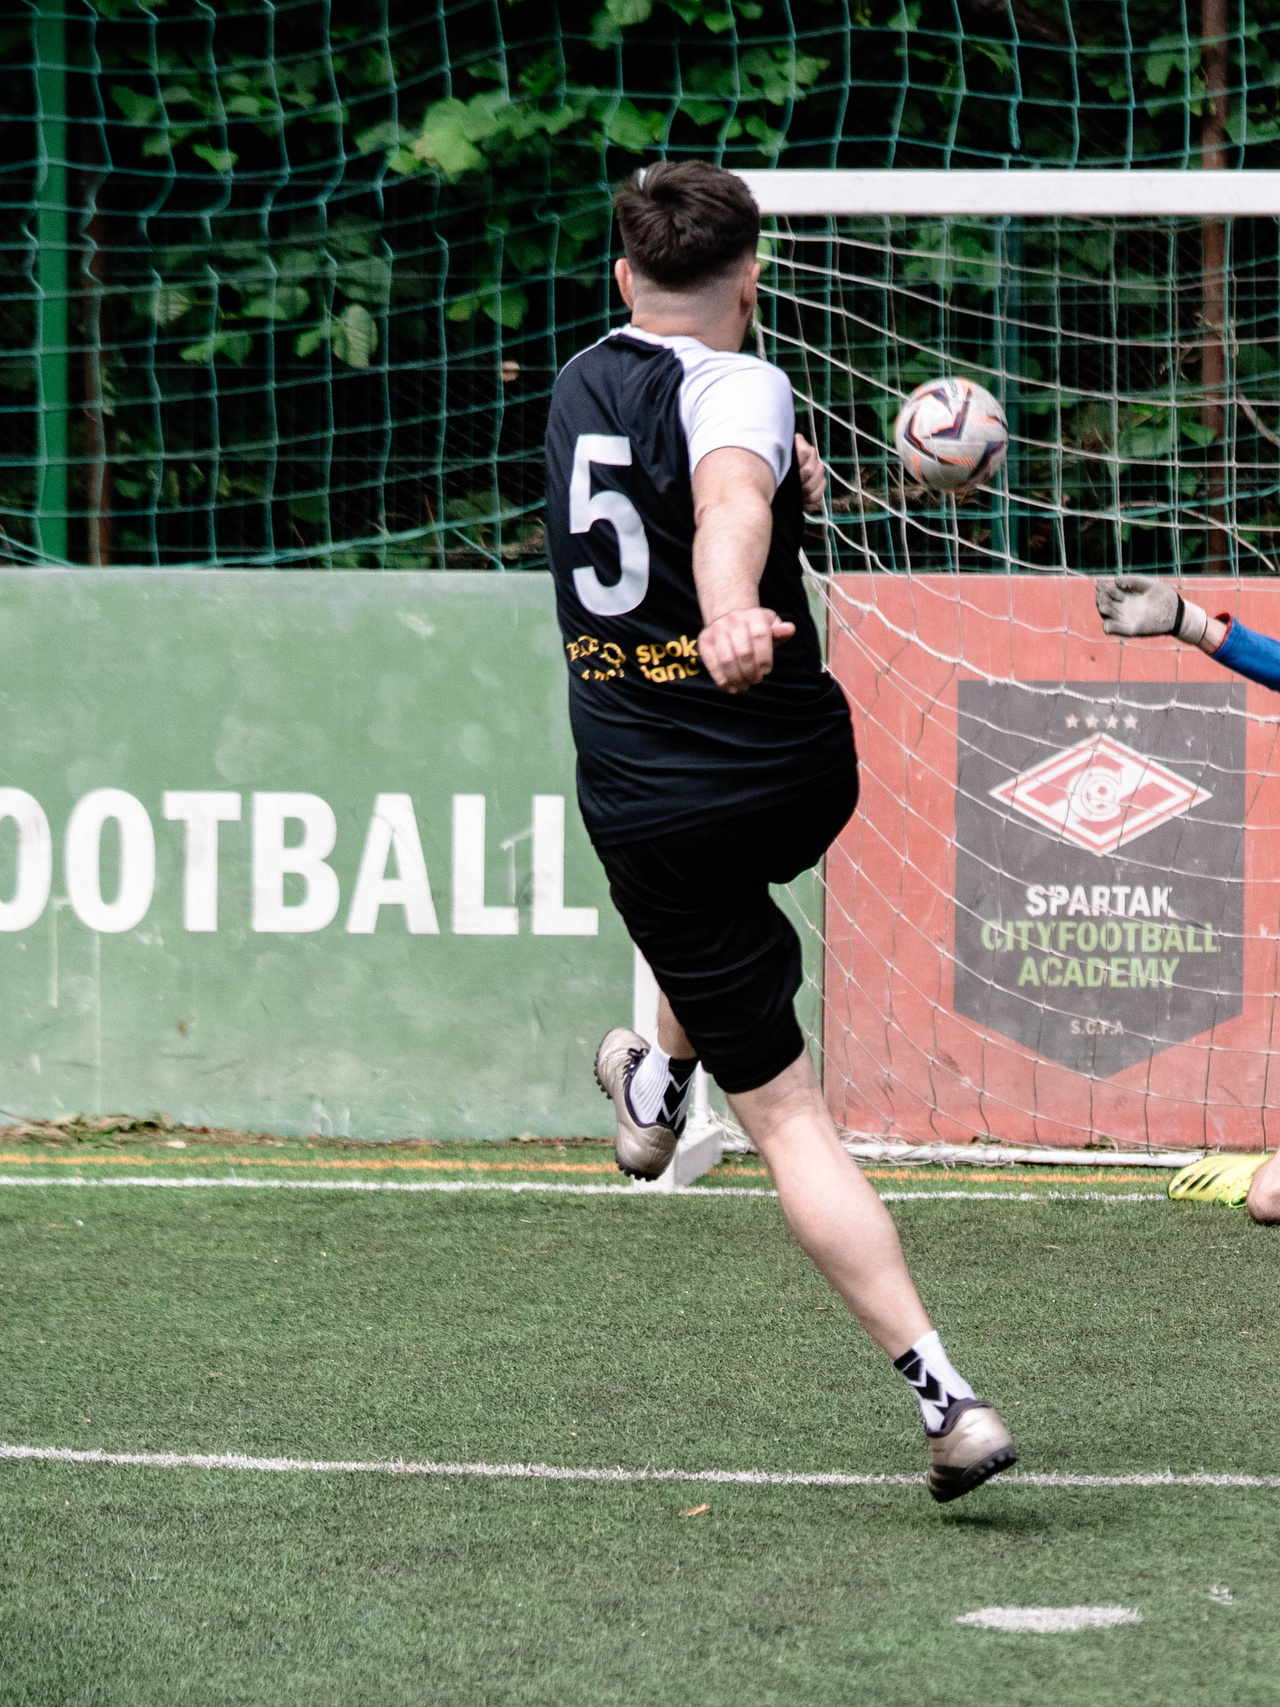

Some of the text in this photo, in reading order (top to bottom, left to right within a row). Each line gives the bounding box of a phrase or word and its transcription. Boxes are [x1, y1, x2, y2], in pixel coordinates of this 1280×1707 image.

[569, 433, 650, 617] 5
[0, 788, 600, 936] OOTBALL
[1025, 884, 1176, 918] SPARTAK
[981, 919, 1222, 953] CITYFOOTBALL
[1018, 956, 1181, 989] ACADEMY
